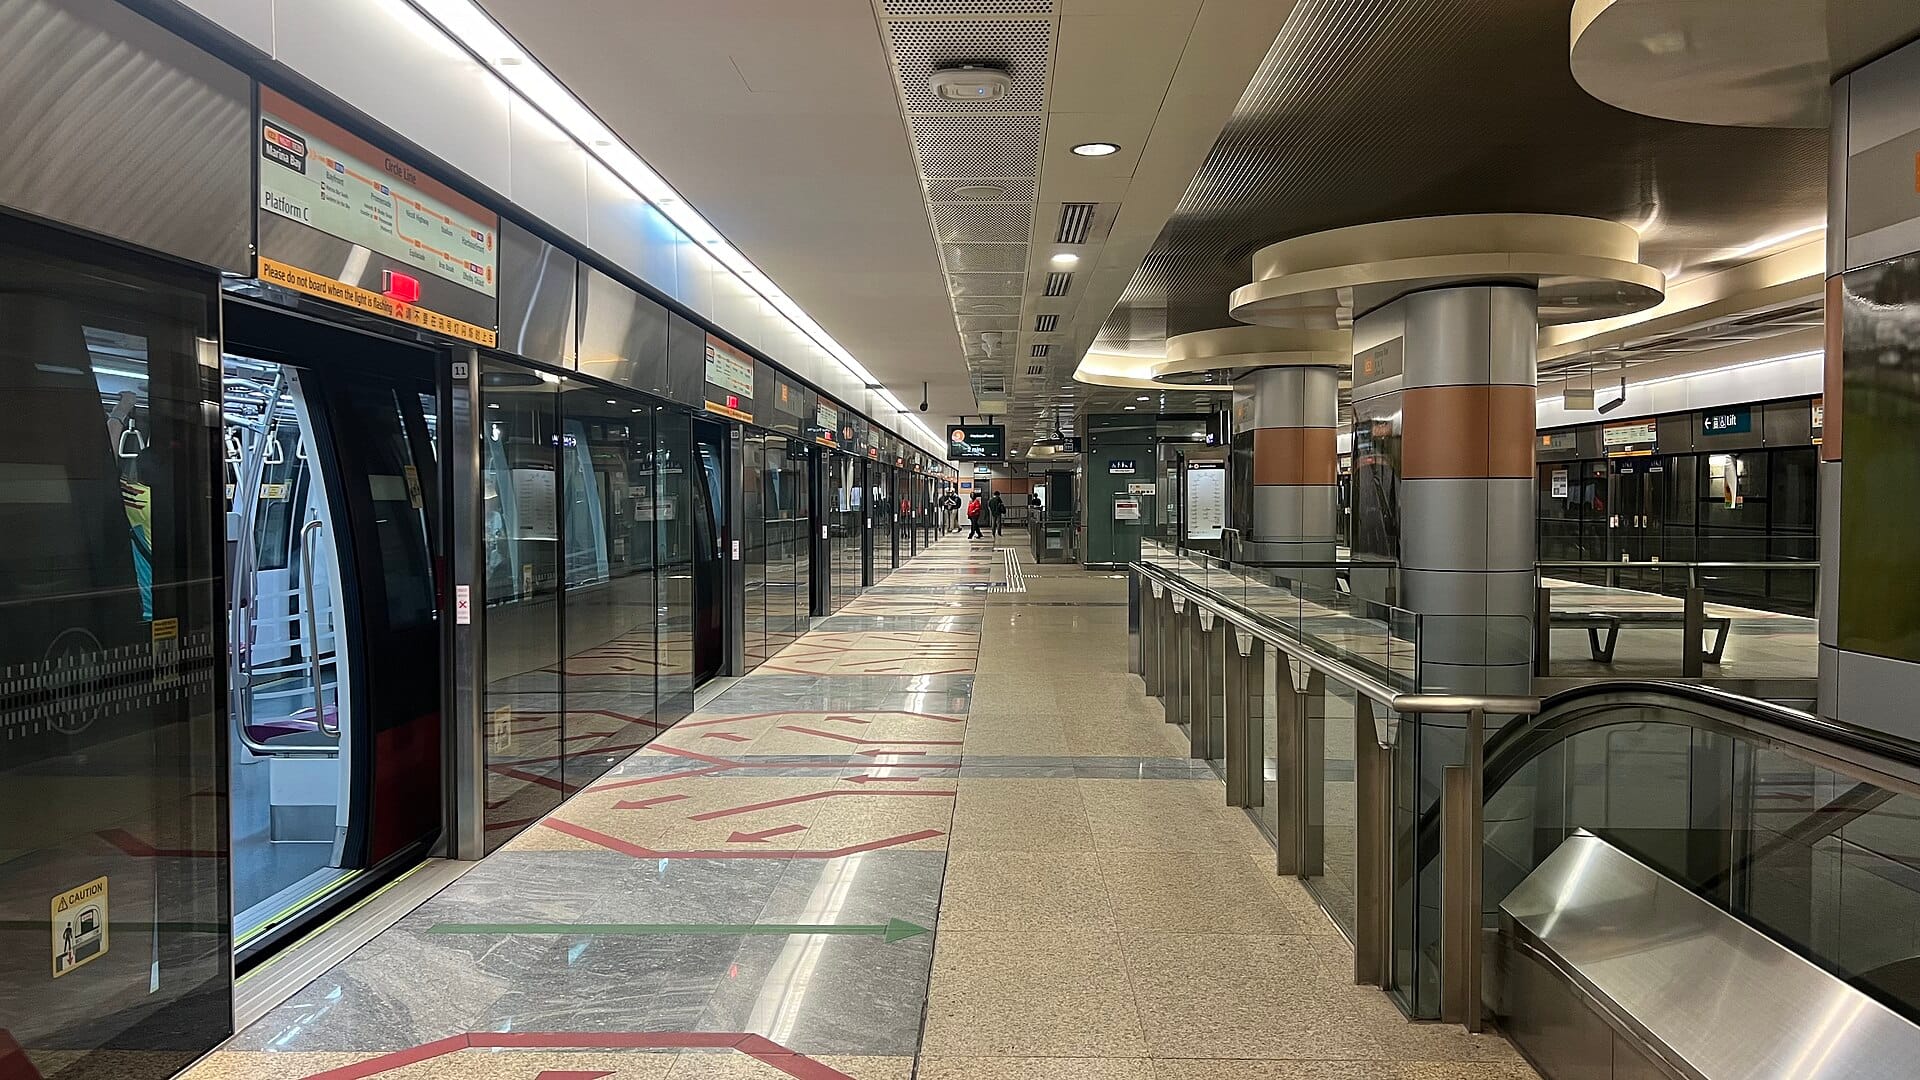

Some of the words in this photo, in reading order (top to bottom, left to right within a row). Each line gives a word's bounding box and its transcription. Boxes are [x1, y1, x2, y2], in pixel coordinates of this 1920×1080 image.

[265, 143, 289, 163] Marina
[290, 154, 302, 171] Bay
[384, 158, 403, 177] Circle
[403, 169, 417, 184] Line
[265, 191, 301, 219] Platform
[303, 207, 309, 221] C
[264, 263, 286, 281] Please
[286, 270, 296, 284] do
[297, 276, 308, 287] not
[309, 279, 327, 293] board
[327, 285, 344, 298] when
[344, 289, 354, 302] the
[354, 292, 368, 306] light
[368, 296, 373, 306] is
[373, 297, 393, 316] flashing
[455, 366, 466, 376] 11
[1726, 414, 1737, 426] Lift
[68, 883, 103, 905] CAUTION
